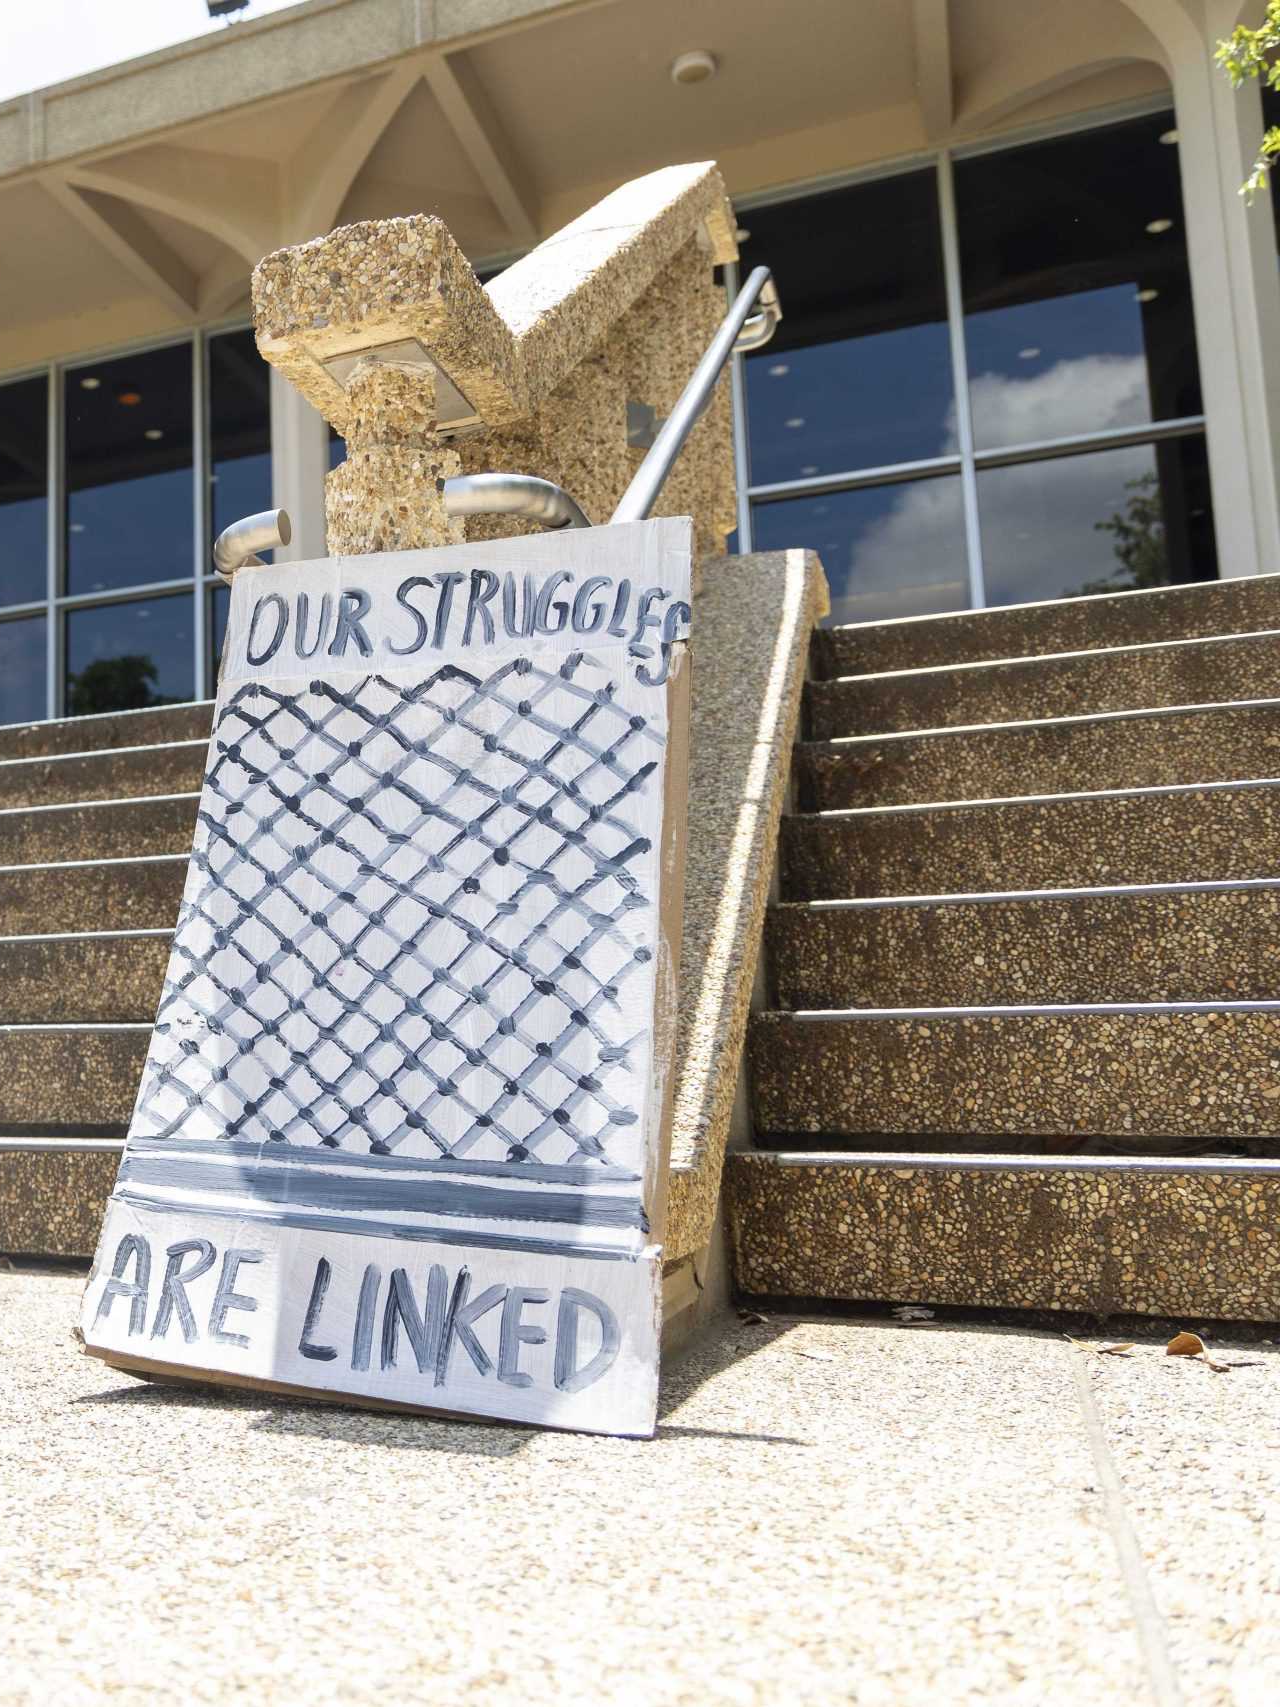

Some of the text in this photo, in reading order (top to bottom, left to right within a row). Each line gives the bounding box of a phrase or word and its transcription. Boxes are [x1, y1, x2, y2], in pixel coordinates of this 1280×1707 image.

[246, 568, 691, 687] OUR STRUGGLES
[90, 1232, 622, 1394] ARE LINKED
